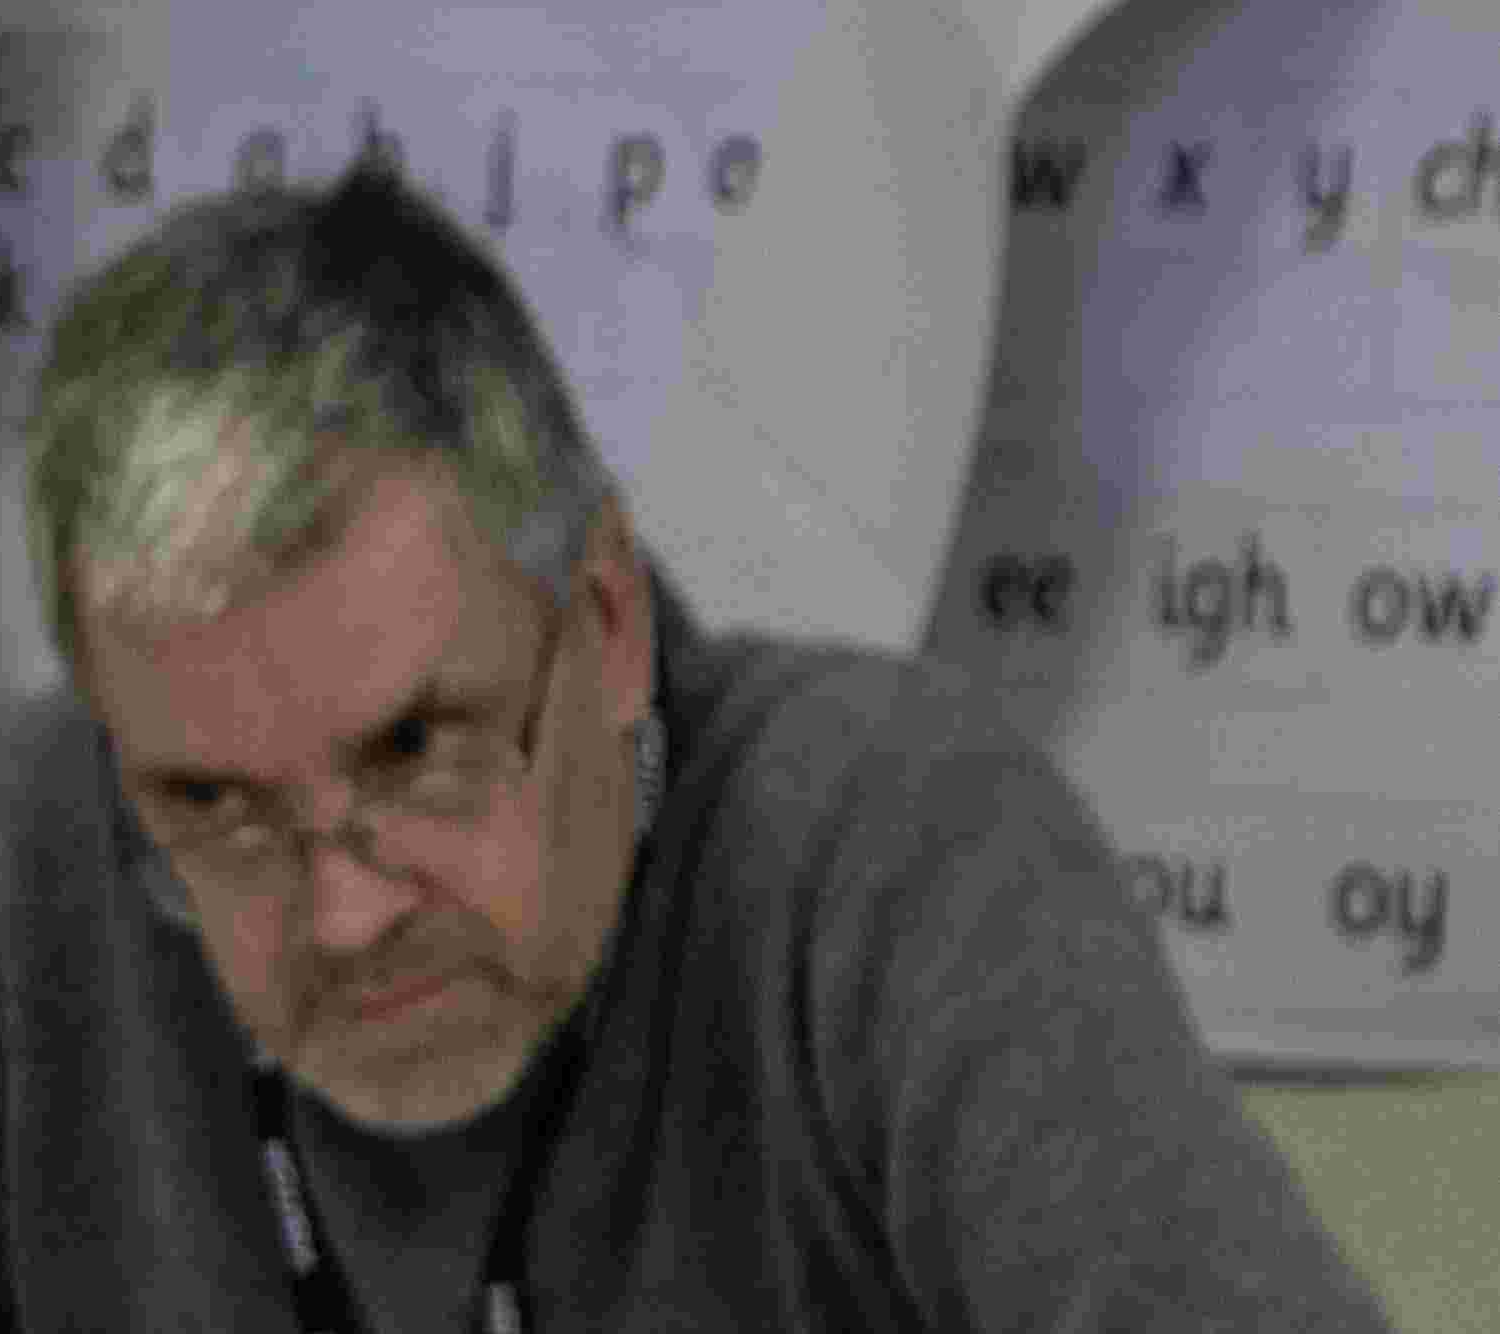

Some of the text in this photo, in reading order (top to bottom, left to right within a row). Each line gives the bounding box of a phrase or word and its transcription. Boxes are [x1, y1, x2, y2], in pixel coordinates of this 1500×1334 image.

[1296, 142, 1353, 255] y
[1148, 528, 1293, 677] igh
[1348, 563, 1497, 646] ow
[1325, 860, 1448, 980] oy
